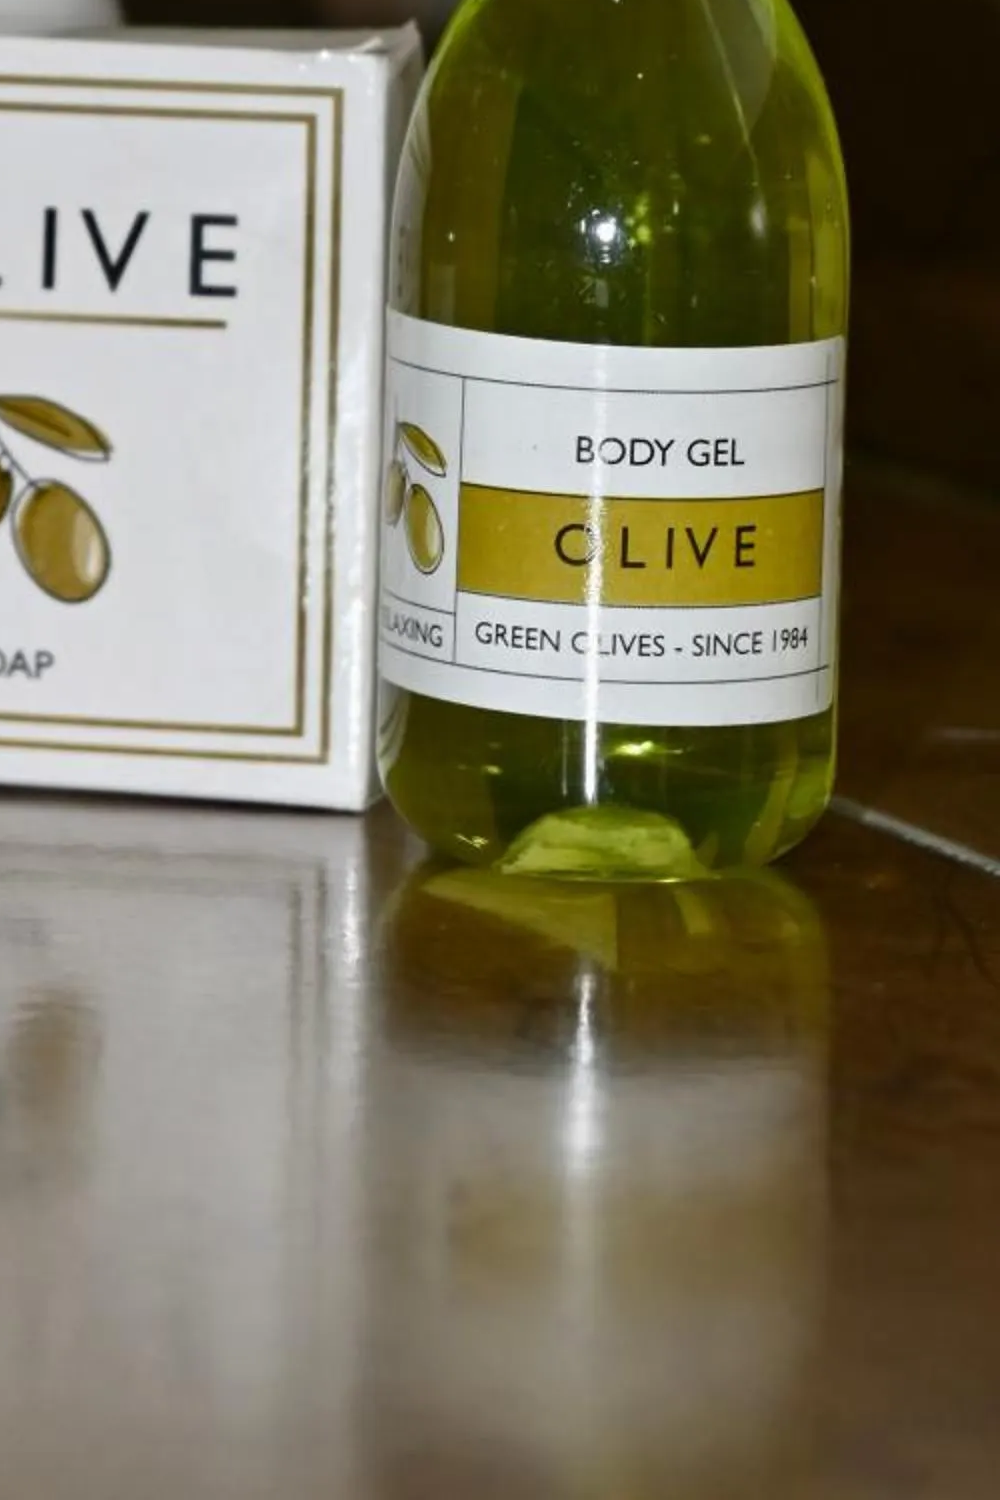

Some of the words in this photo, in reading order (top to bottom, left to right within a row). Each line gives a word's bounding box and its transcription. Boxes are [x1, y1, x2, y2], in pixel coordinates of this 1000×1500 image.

[575, 435, 675, 467] BODY
[686, 438, 745, 467] GEL
[554, 522, 758, 570] OLIVE
[475, 621, 561, 653] GREEN
[692, 630, 763, 657] SINCE
[773, 626, 808, 652] 1984
